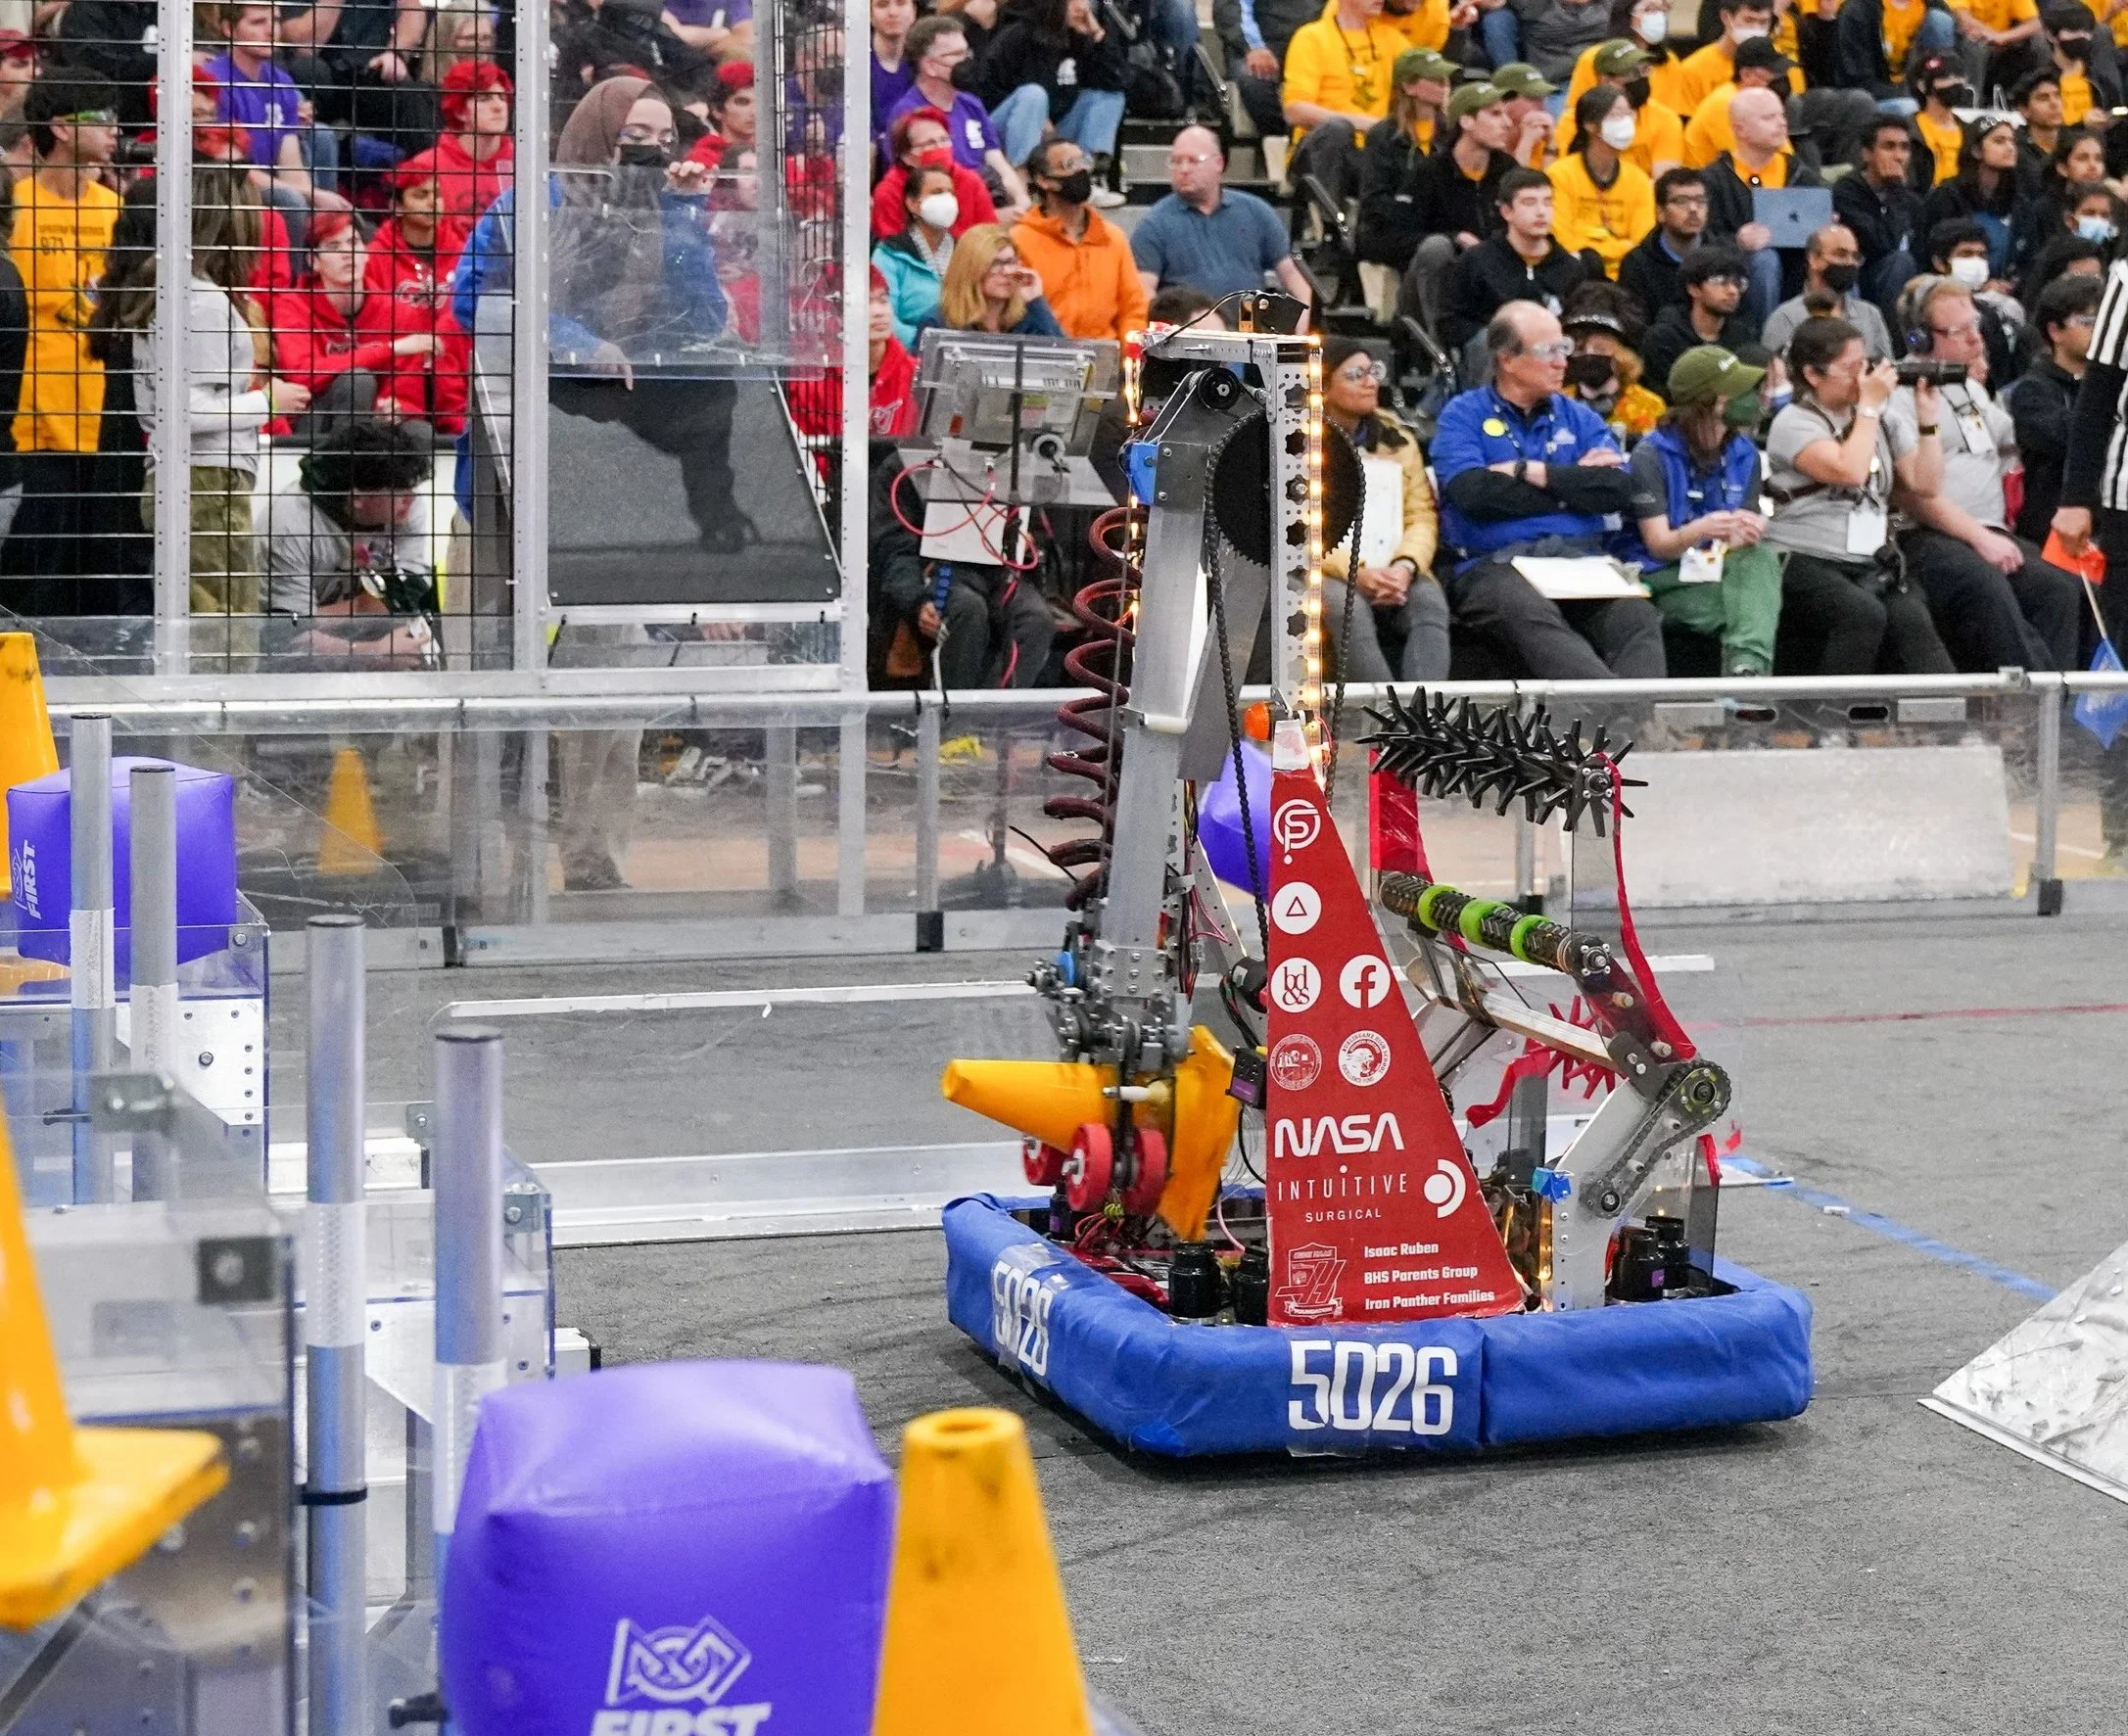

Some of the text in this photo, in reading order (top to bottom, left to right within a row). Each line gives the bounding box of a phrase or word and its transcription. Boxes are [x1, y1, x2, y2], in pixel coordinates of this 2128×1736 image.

[24, 839, 42, 919] FIRST
[1274, 1111, 1405, 1158] NASA
[1305, 1208, 1382, 1223] SURGICAL
[1364, 1242, 1440, 1258] Isaac Ruben
[1364, 1266, 1478, 1285] BHS Parents Group
[1365, 1289, 1495, 1310] Iron Panther Families
[993, 1260, 1054, 1377] 5026
[1288, 1339, 1458, 1436] 5026
